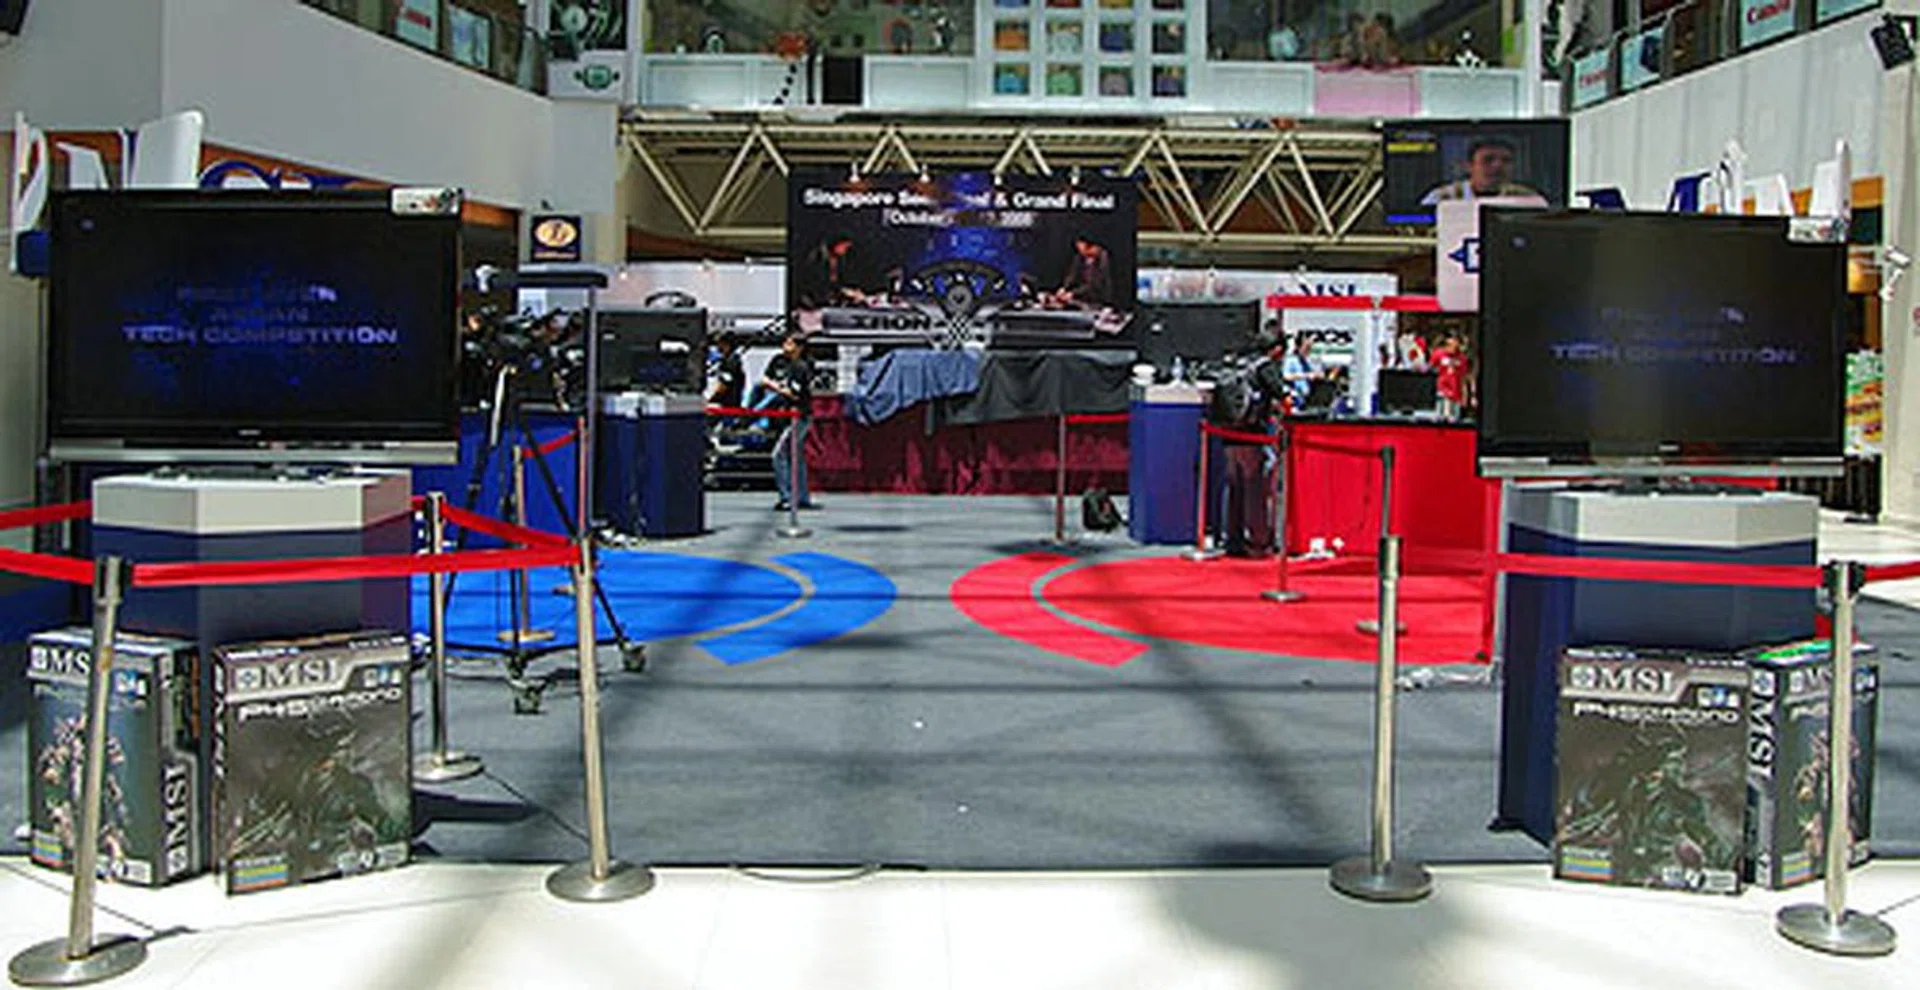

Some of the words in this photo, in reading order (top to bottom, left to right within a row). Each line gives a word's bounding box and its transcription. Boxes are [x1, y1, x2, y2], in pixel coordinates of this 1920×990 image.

[803, 188, 895, 209] Singapore
[1012, 192, 1067, 209] Grand
[1071, 193, 1115, 209] Final
[122, 326, 196, 344] TECH
[265, 656, 342, 687] MSI
[1600, 666, 1674, 693] MSI
[164, 763, 187, 849] MSI
